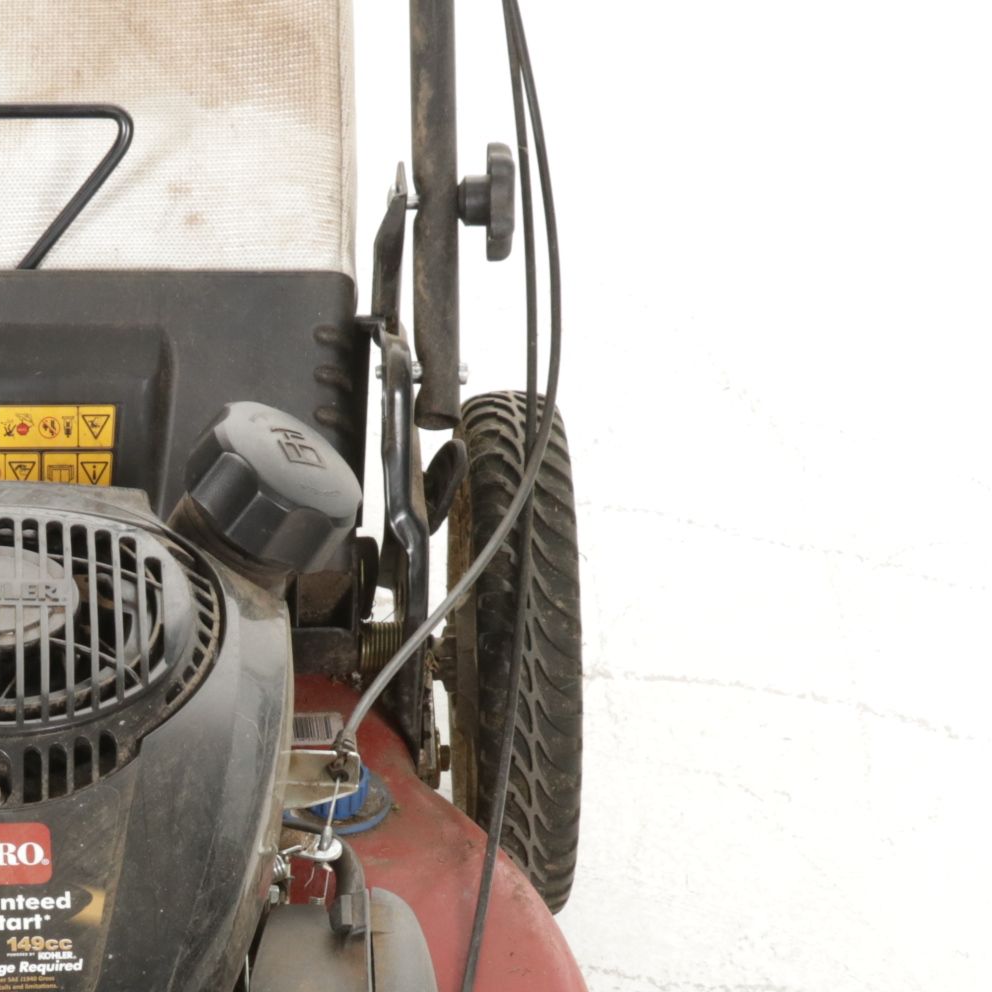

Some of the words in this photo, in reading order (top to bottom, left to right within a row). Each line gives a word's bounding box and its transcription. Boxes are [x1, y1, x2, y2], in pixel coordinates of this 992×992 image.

[6, 936, 73, 951] 149cc
[38, 951, 73, 960] KOHLER
[19, 959, 83, 976] Required
